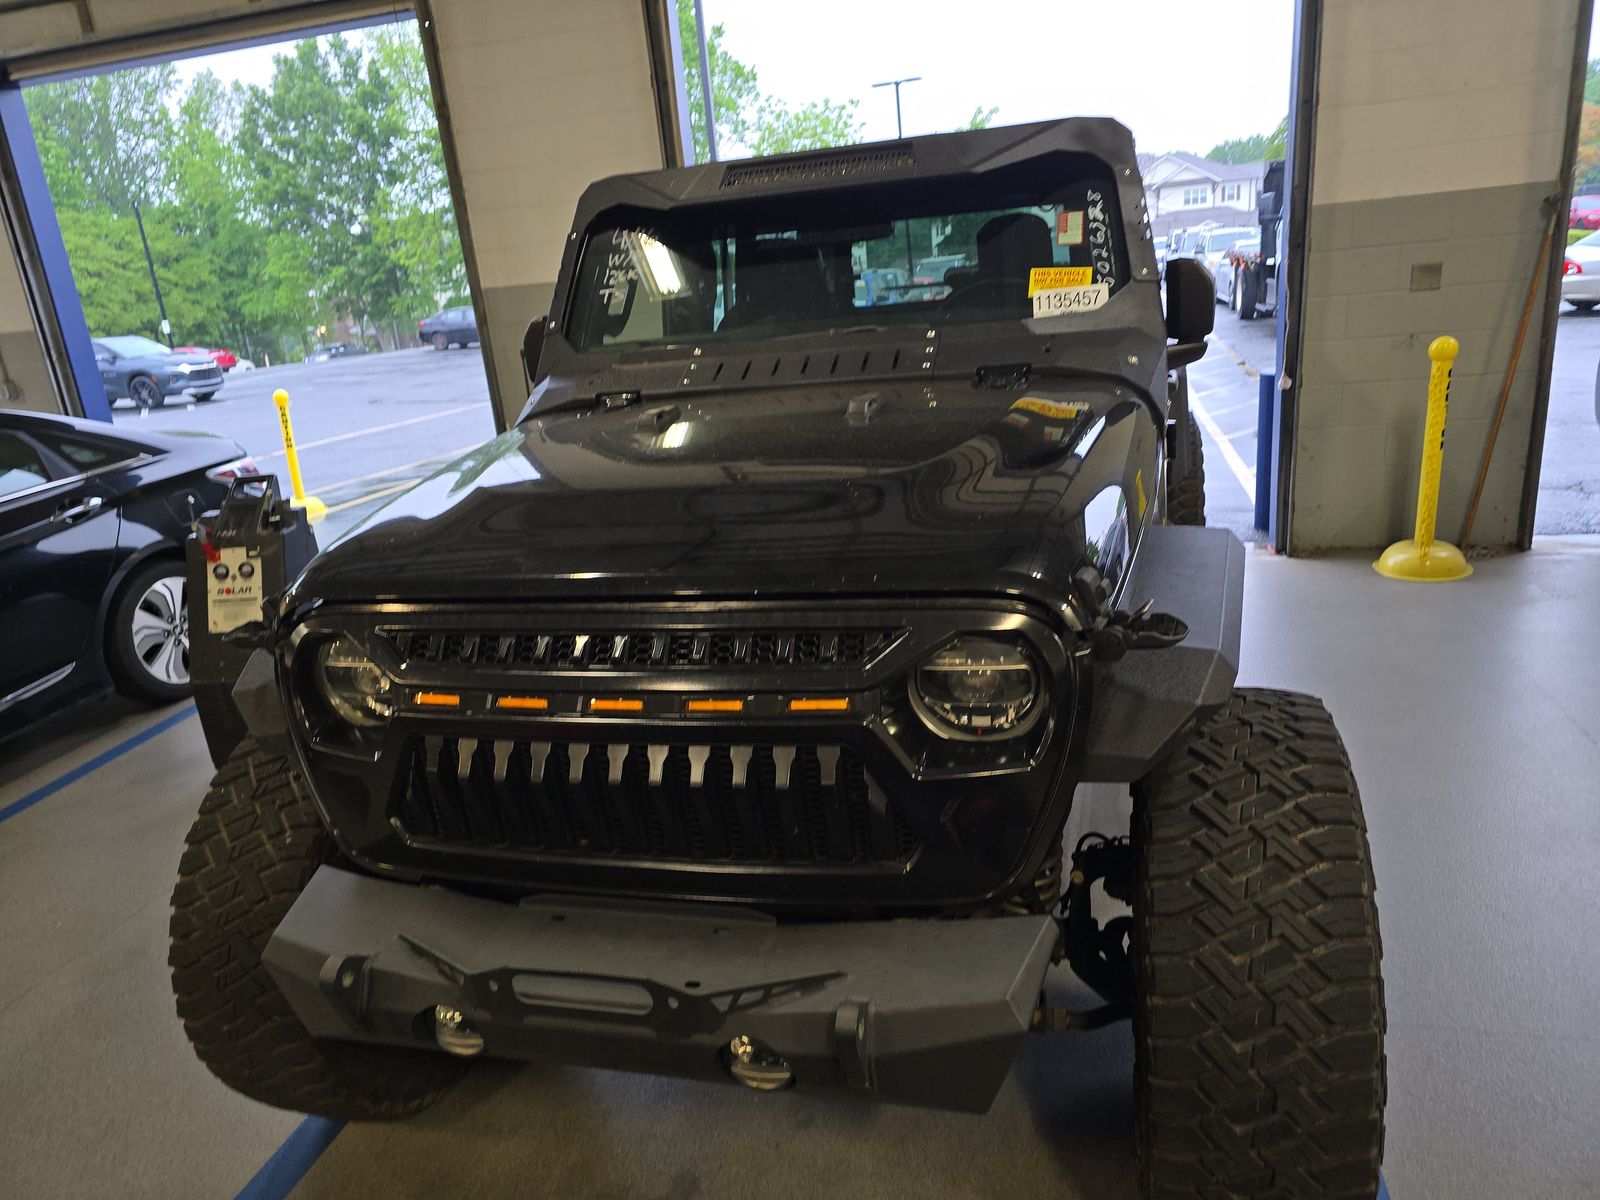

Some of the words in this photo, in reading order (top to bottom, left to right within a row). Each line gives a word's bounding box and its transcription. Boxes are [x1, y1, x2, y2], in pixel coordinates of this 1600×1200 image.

[1035, 289, 1101, 311] 1135457
[279, 406, 293, 449] CAUTION
[217, 585, 252, 596] SOLAR
